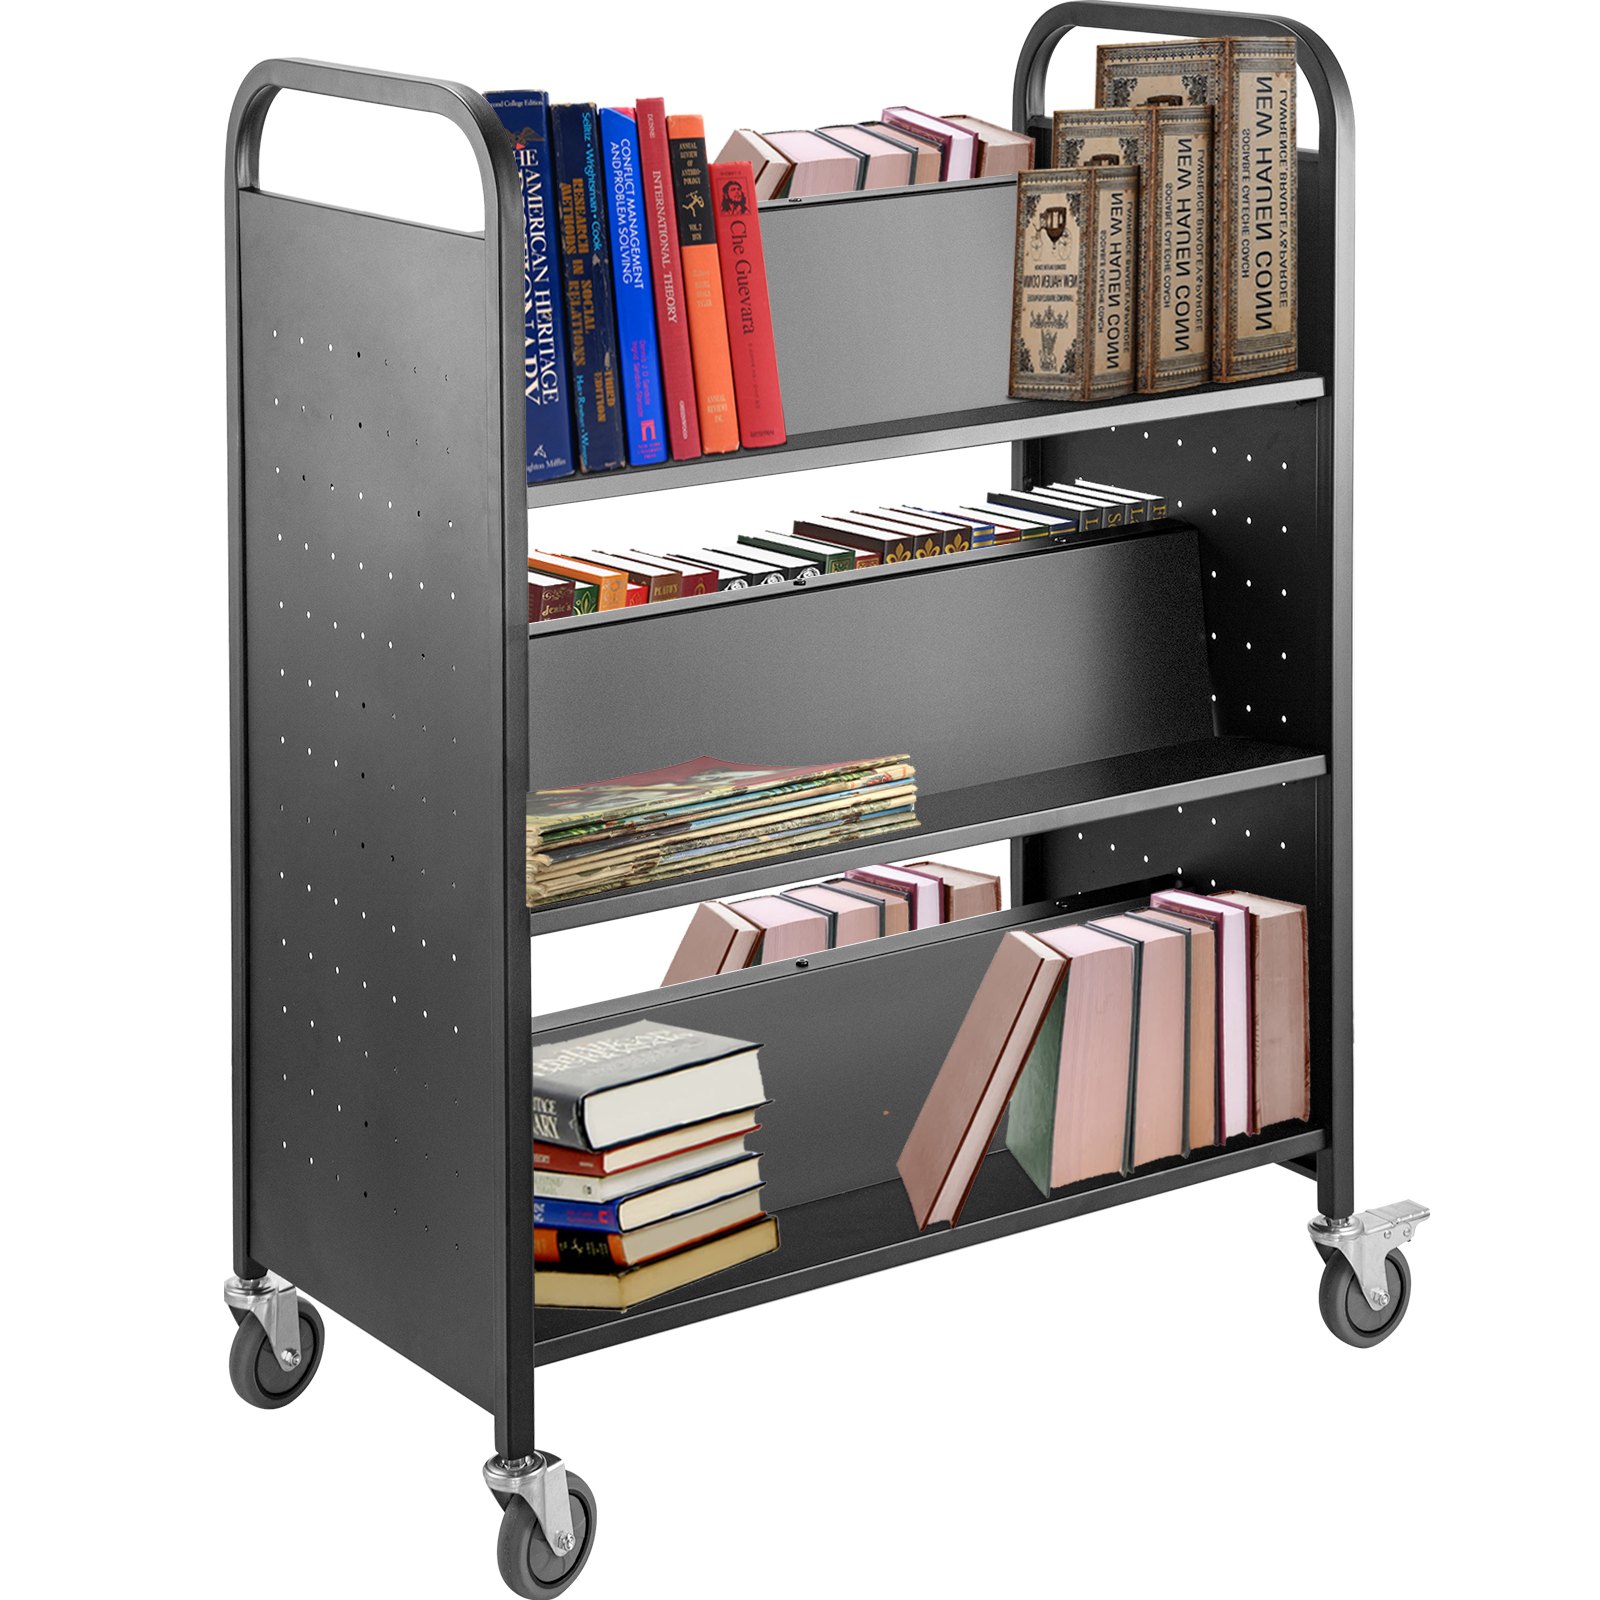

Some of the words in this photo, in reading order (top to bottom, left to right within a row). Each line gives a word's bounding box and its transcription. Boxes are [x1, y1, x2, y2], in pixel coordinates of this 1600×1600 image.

[584, 149, 597, 213] Wrightsman
[592, 221, 602, 250] Cook
[621, 139, 635, 196] CONFLICT
[525, 169, 549, 282] AMERICAN
[560, 182, 577, 255] METHODS
[572, 178, 589, 254] RESEARCH
[627, 199, 644, 289] MANAGEMENT
[653, 171, 669, 268] INTERNATIONAL
[663, 272, 677, 324] THEORY
[730, 221, 747, 255] Che
[572, 259, 584, 275] IN
[618, 227, 633, 284] SOLVING
[568, 281, 586, 366] RELATIONS
[581, 280, 595, 330] SOCIAL
[735, 259, 754, 335] Guevara
[534, 289, 559, 405] HERITAGE
[594, 372, 606, 422] EDITION
[604, 369, 616, 407] THIRD
[654, 584, 679, 596] PLATO'S
